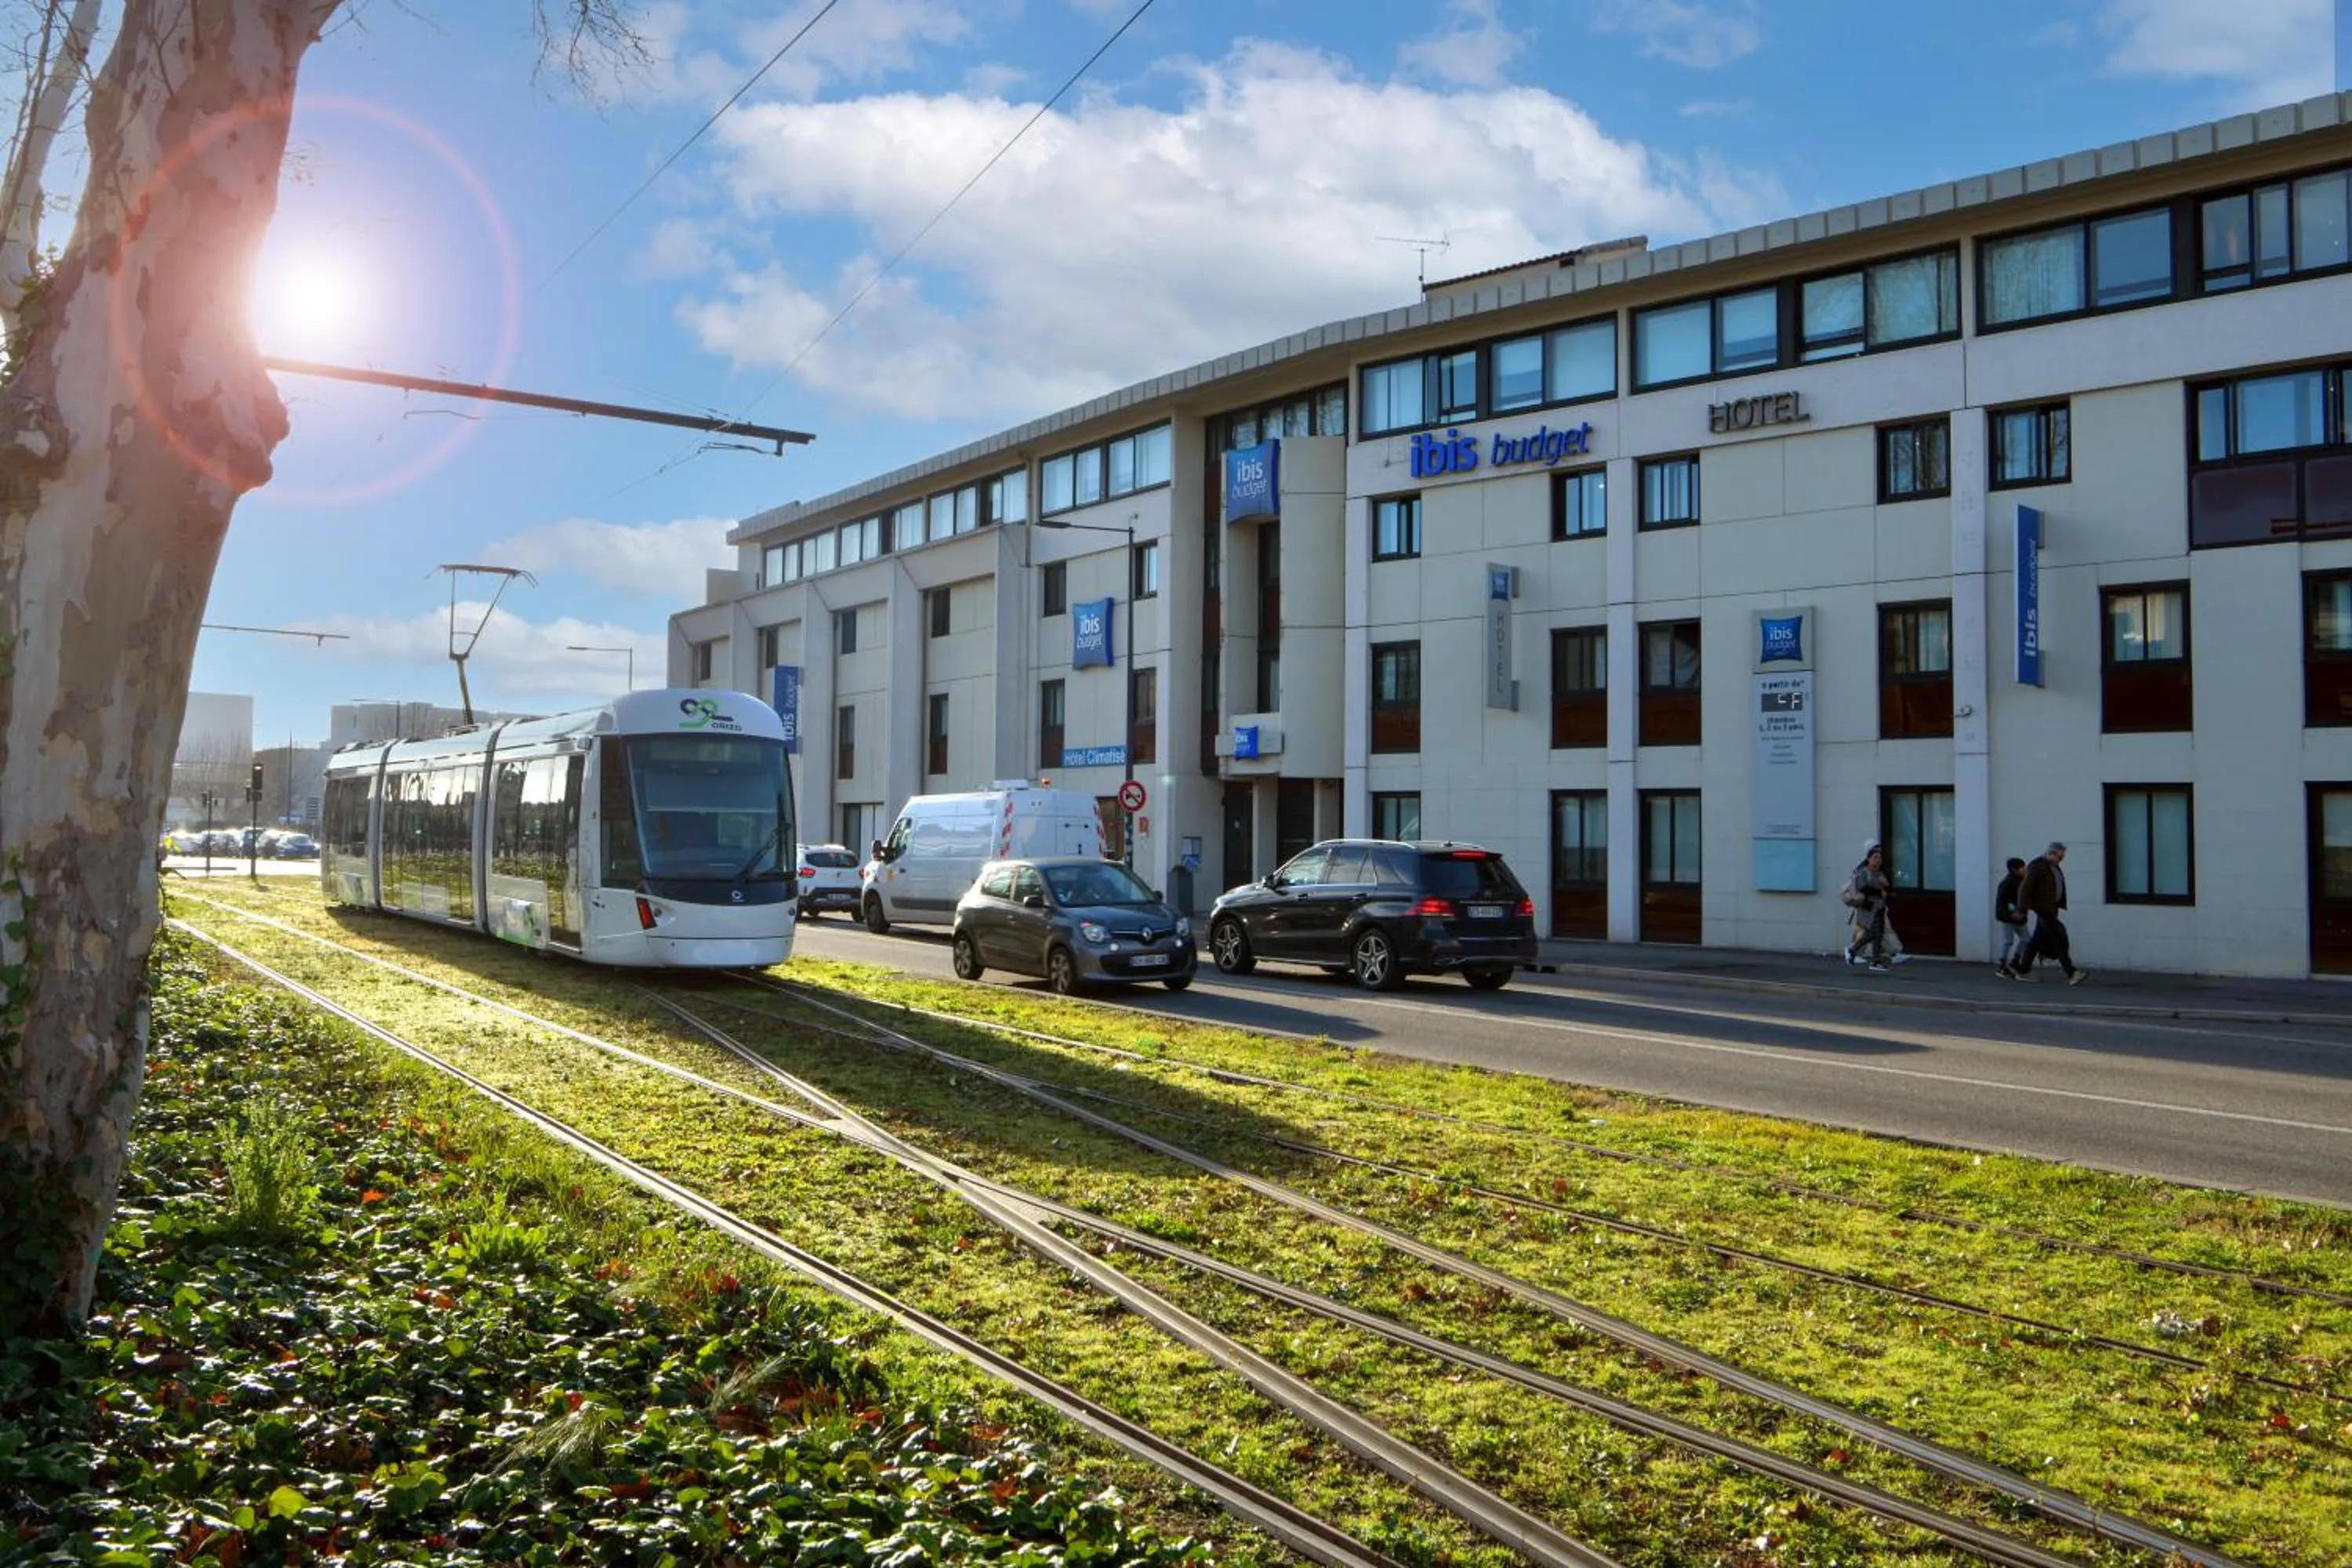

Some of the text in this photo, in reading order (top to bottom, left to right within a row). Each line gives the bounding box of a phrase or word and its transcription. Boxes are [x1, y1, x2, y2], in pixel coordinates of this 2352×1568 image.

[1708, 390, 1810, 434] HOTEL
[1410, 422, 1593, 478] ibis budget
[1237, 458, 1264, 483] ibis
[1232, 479, 1267, 499] budget
[1080, 612, 1101, 635] ibis
[1769, 626, 1793, 640] ibis
[2024, 608, 2037, 657] ibis
